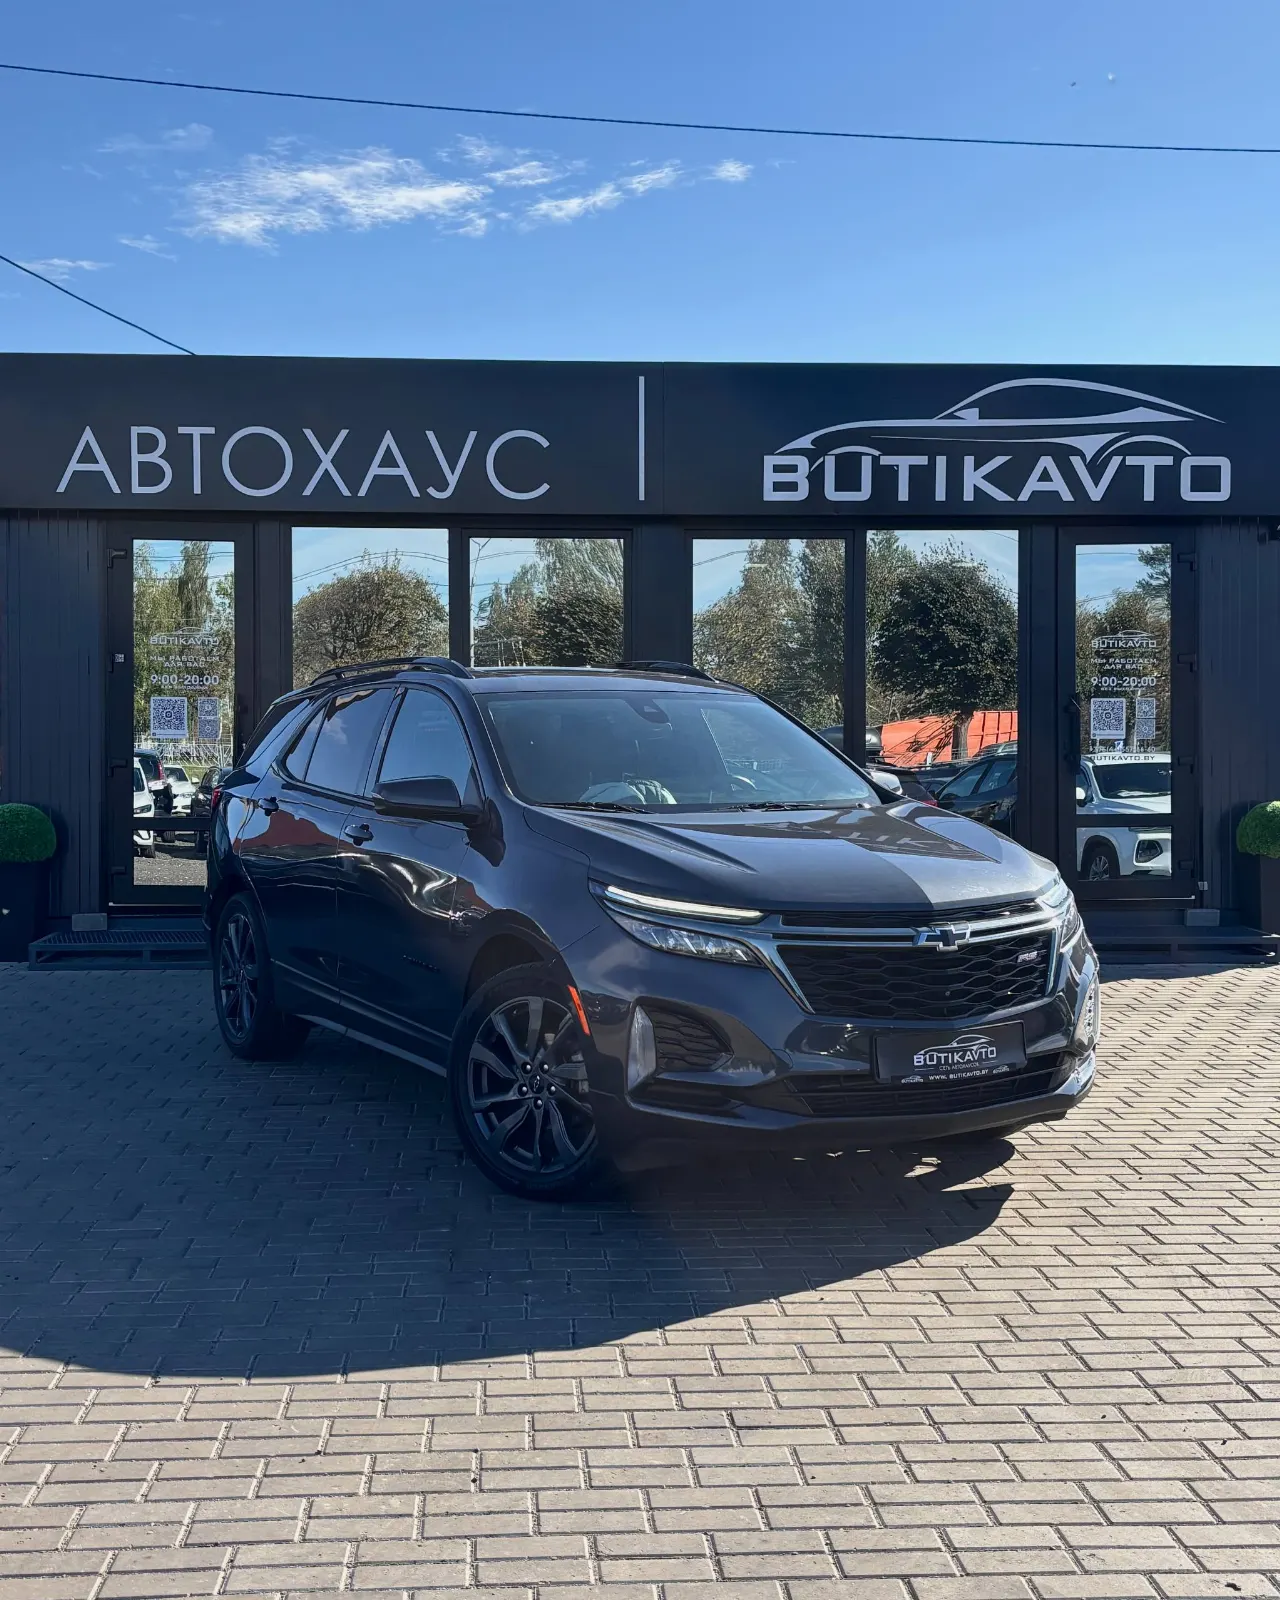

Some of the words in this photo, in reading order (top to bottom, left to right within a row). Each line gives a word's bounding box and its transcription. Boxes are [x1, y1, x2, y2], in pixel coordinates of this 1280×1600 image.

[56, 425, 551, 500] АВТОХАУС
[763, 455, 1232, 502] BUTIKAVTO
[1091, 640, 1157, 648] BUTIKAVTO
[150, 675, 220, 685] 9:00-20:00
[1091, 676, 1157, 687] 9:00-20:00
[913, 1046, 997, 1066] BUTIKAVTO
